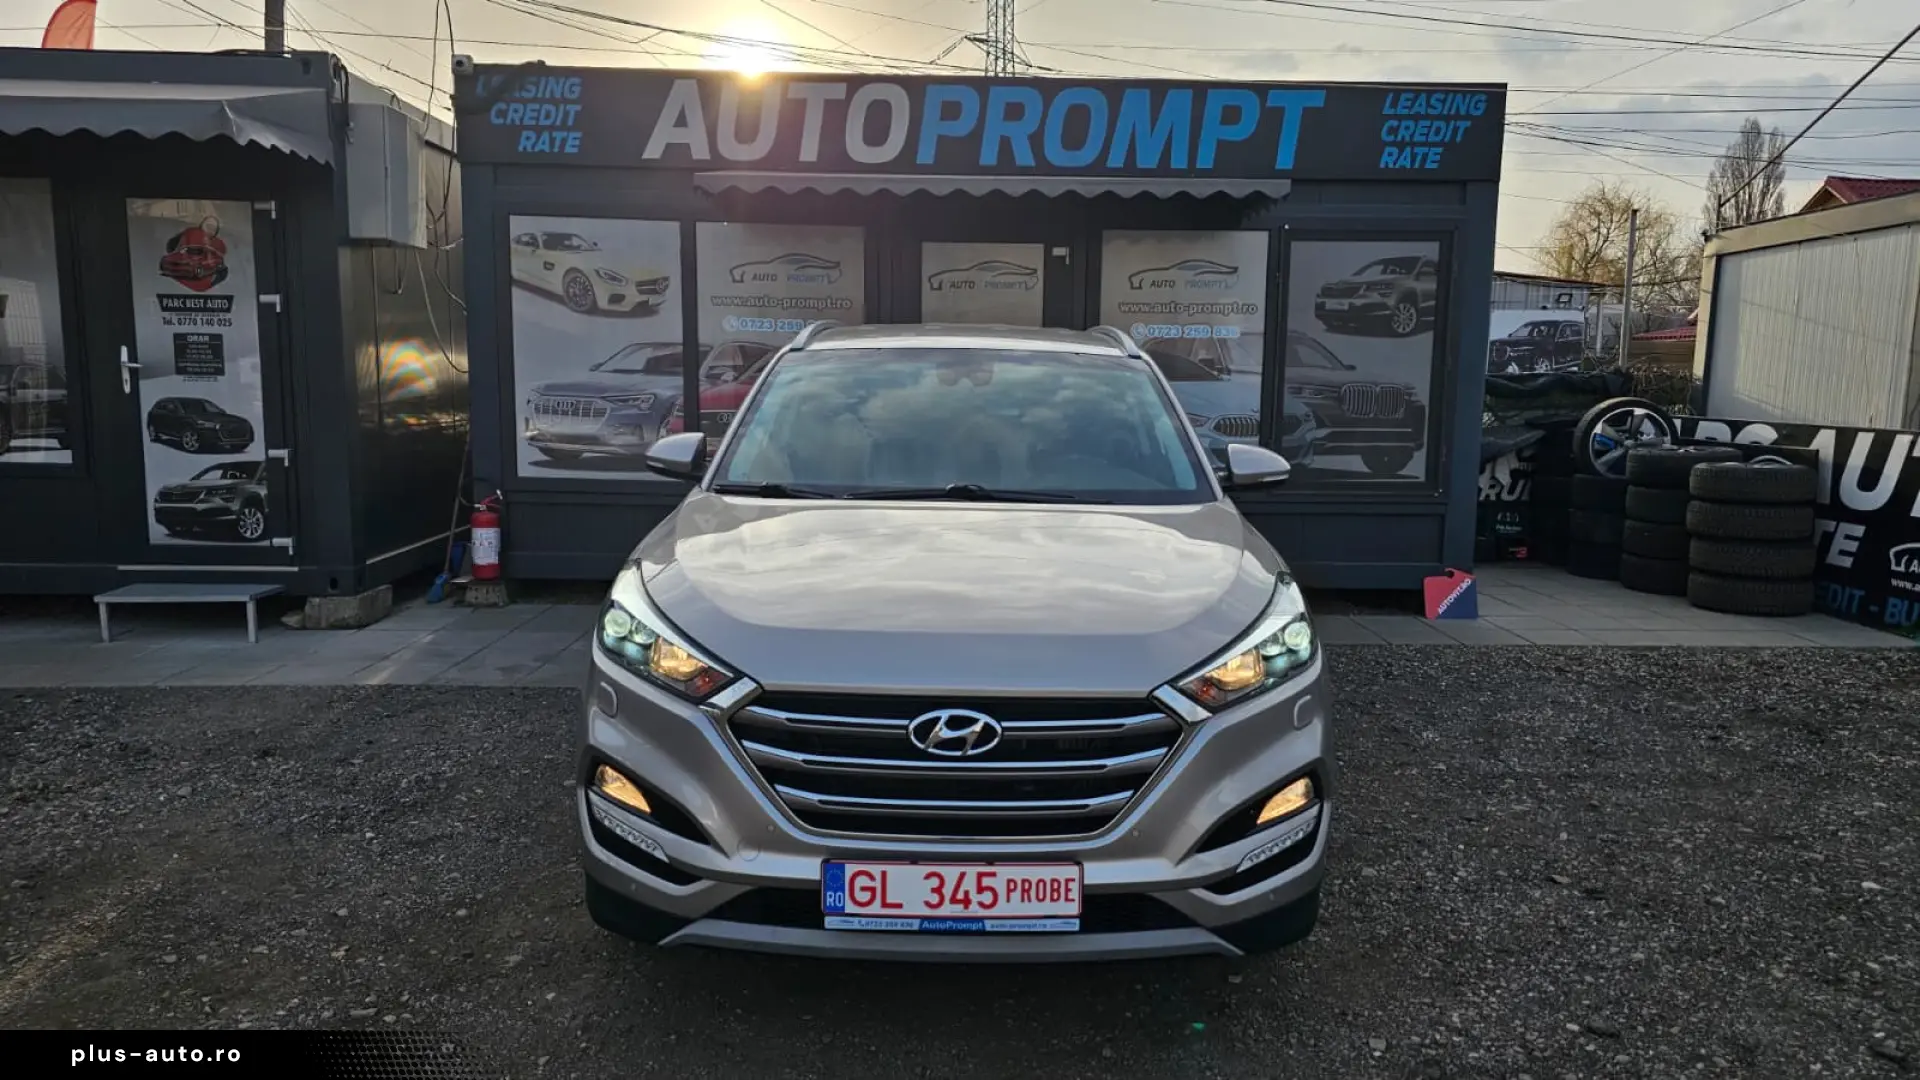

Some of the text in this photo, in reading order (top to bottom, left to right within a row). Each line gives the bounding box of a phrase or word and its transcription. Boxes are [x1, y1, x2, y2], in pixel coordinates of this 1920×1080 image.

[476, 75, 583, 99] LSING
[1382, 91, 1488, 115] LEASING
[490, 101, 582, 126] CREDIT
[642, 79, 1326, 170] AUTOPROMPT
[1381, 119, 1471, 143] CREDIT
[518, 130, 582, 153] RATE
[1380, 146, 1444, 168] RATE
[751, 273, 778, 282] AUTO
[949, 280, 975, 290] AUTO
[1149, 280, 1176, 289] AUTO
[162, 298, 185, 308] PARC
[206, 298, 229, 308] AUTO
[711, 295, 853, 311] www.auto-prompt.ro
[1118, 301, 1259, 317] www.auto-prompt.ro
[740, 319, 773, 331] 0723
[1147, 326, 1180, 337] 0723
[1185, 326, 1210, 337] 259
[849, 869, 1076, 910] GL 345 PROBE
[826, 891, 844, 908] RO
[922, 920, 985, 931] AutoPrompt
